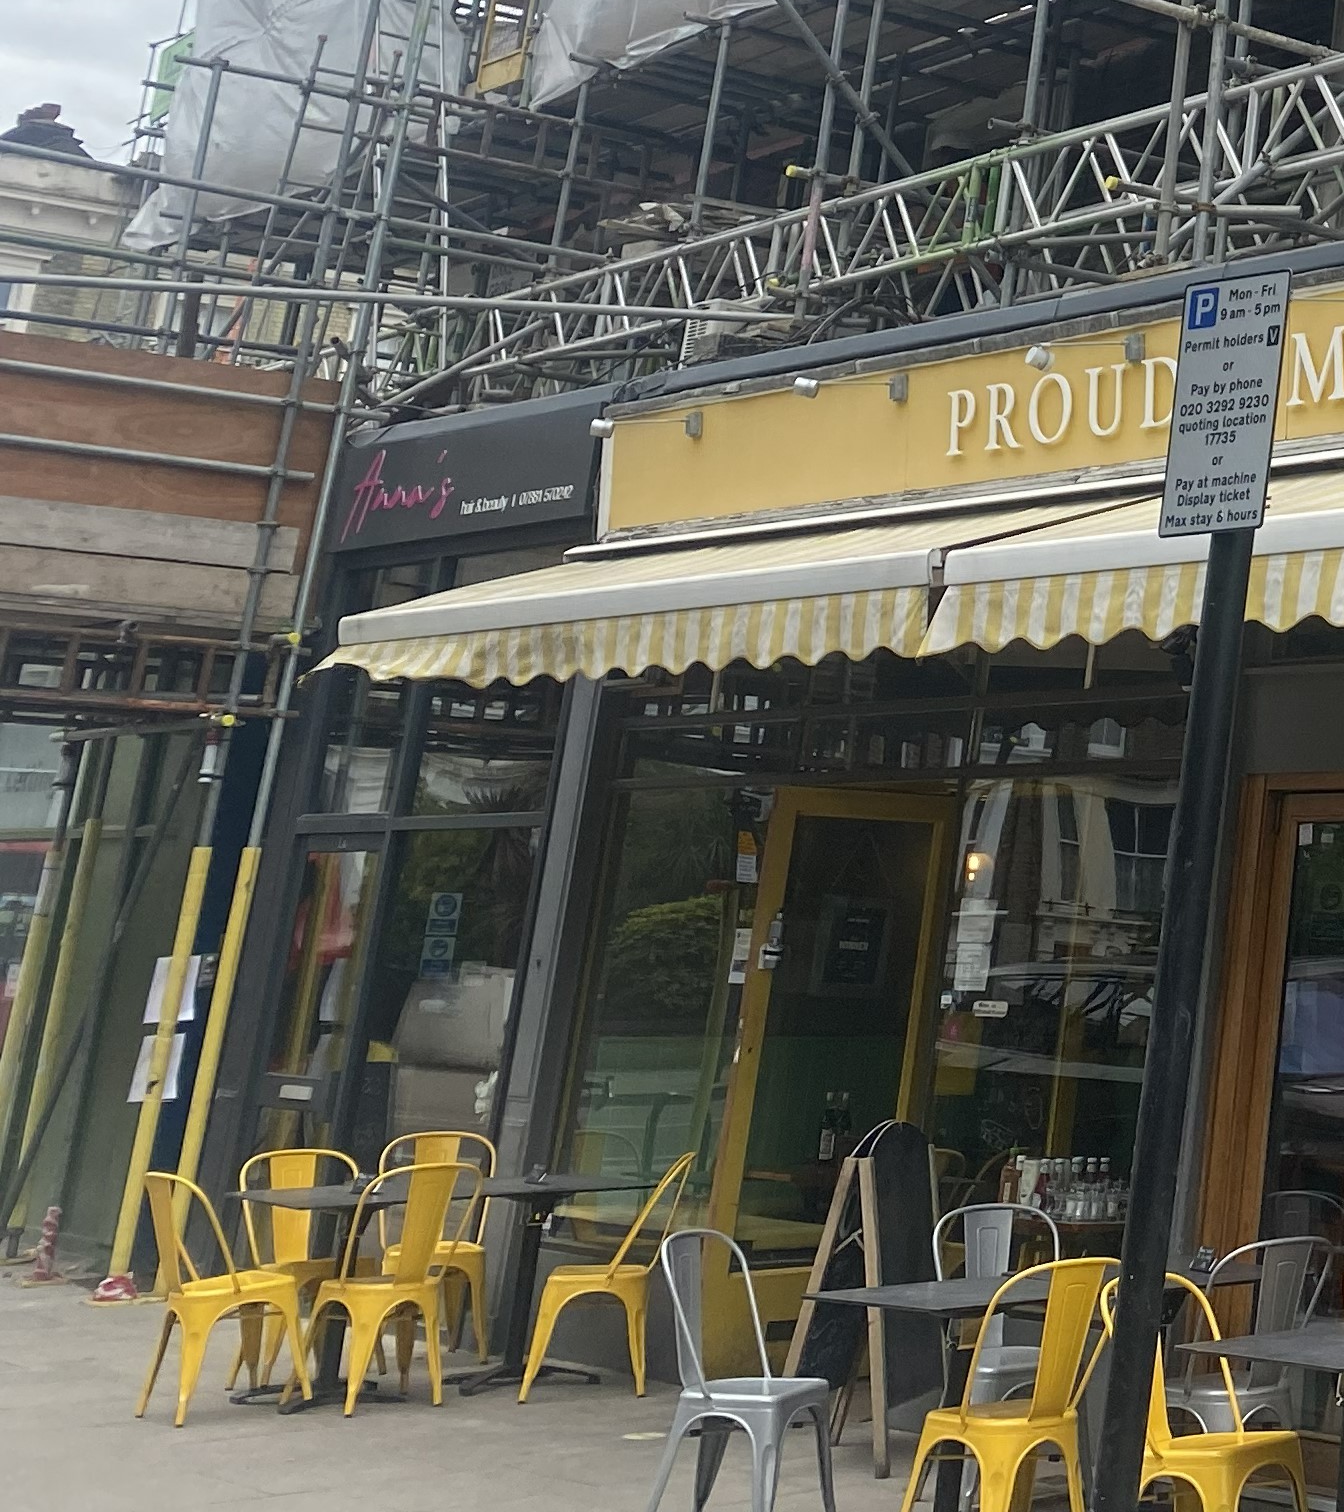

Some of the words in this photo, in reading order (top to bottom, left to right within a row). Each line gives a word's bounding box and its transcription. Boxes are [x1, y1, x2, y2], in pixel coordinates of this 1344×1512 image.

[1229, 289, 1253, 301] Mon
[1261, 283, 1277, 297] Fri
[1195, 292, 1215, 326] P
[1184, 337, 1220, 353] Permit
[1223, 333, 1264, 348] holders
[1267, 326, 1280, 345] V
[1222, 361, 1234, 372] or
[1190, 384, 1210, 397] Pay
[1213, 381, 1227, 395] by
[1229, 378, 1263, 394] phone
[946, 356, 1178, 456] PROUD
[1180, 402, 1203, 417] 020
[1206, 398, 1235, 413] 3292
[1239, 394, 1269, 409] 9230
[1178, 418, 1219, 435] quoting
[1222, 412, 1267, 428] location
[1204, 430, 1236, 446] 17735
[1211, 456, 1223, 466] or
[1175, 478, 1194, 492] Pay
[1197, 476, 1209, 488] at
[1211, 472, 1257, 487] machine
[1176, 491, 1216, 508] Display
[1219, 487, 1251, 503] ticket
[1165, 515, 1187, 528] Max
[1190, 512, 1213, 527] stay
[1227, 509, 1258, 522] hours
